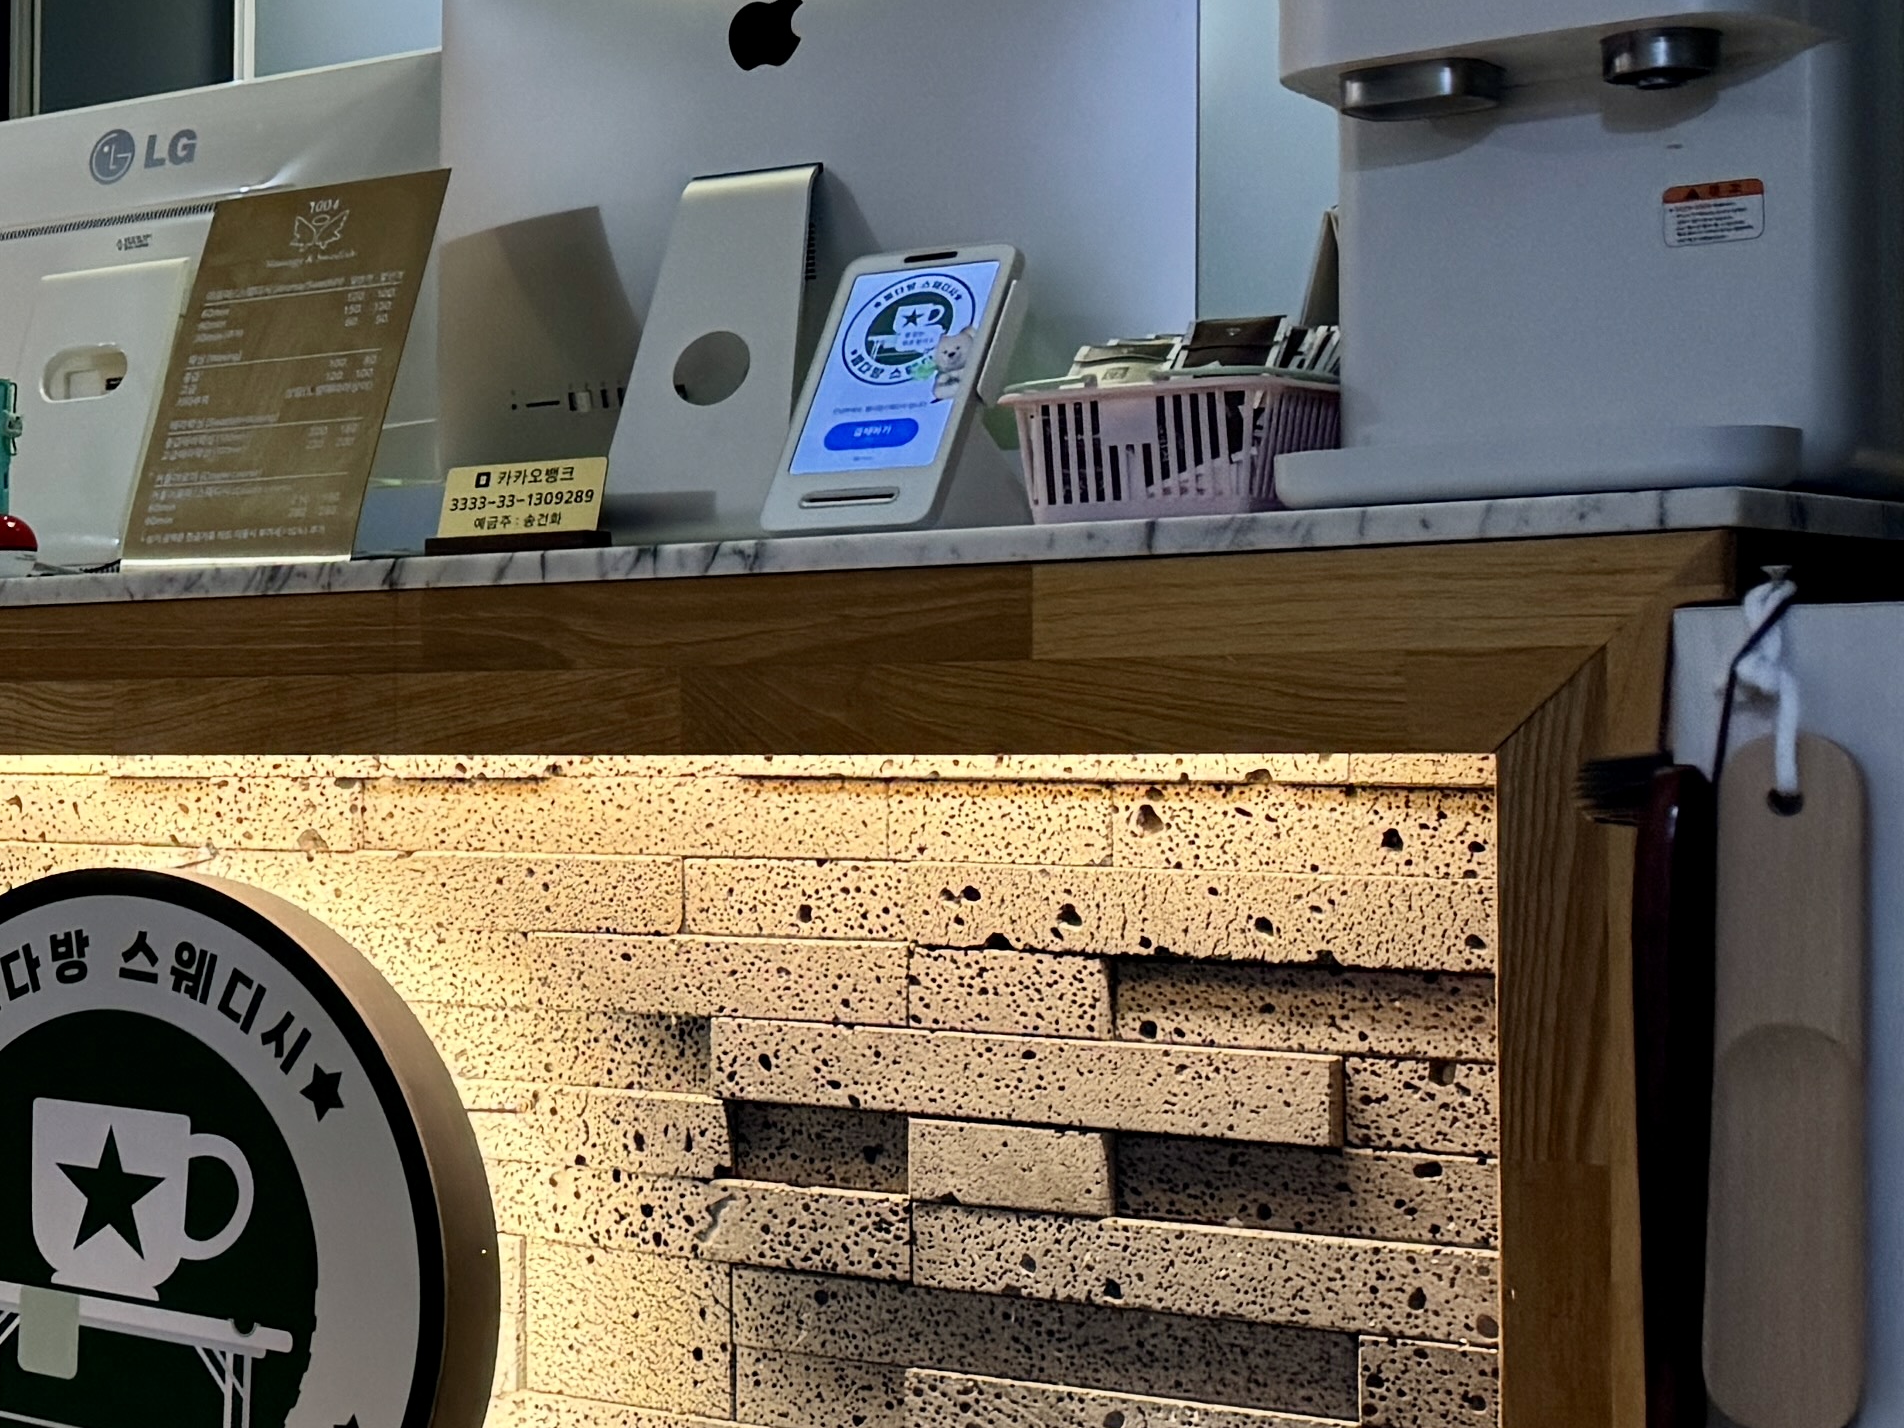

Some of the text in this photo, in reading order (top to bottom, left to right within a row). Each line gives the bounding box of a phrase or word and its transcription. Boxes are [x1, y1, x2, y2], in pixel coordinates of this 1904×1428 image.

[144, 128, 197, 169] LG
[497, 466, 575, 486] 카카오뱅크
[449, 489, 595, 512] 3333-33-1309289
[474, 515, 512, 530] 예금주
[119, 930, 313, 1074] 스웨디시
